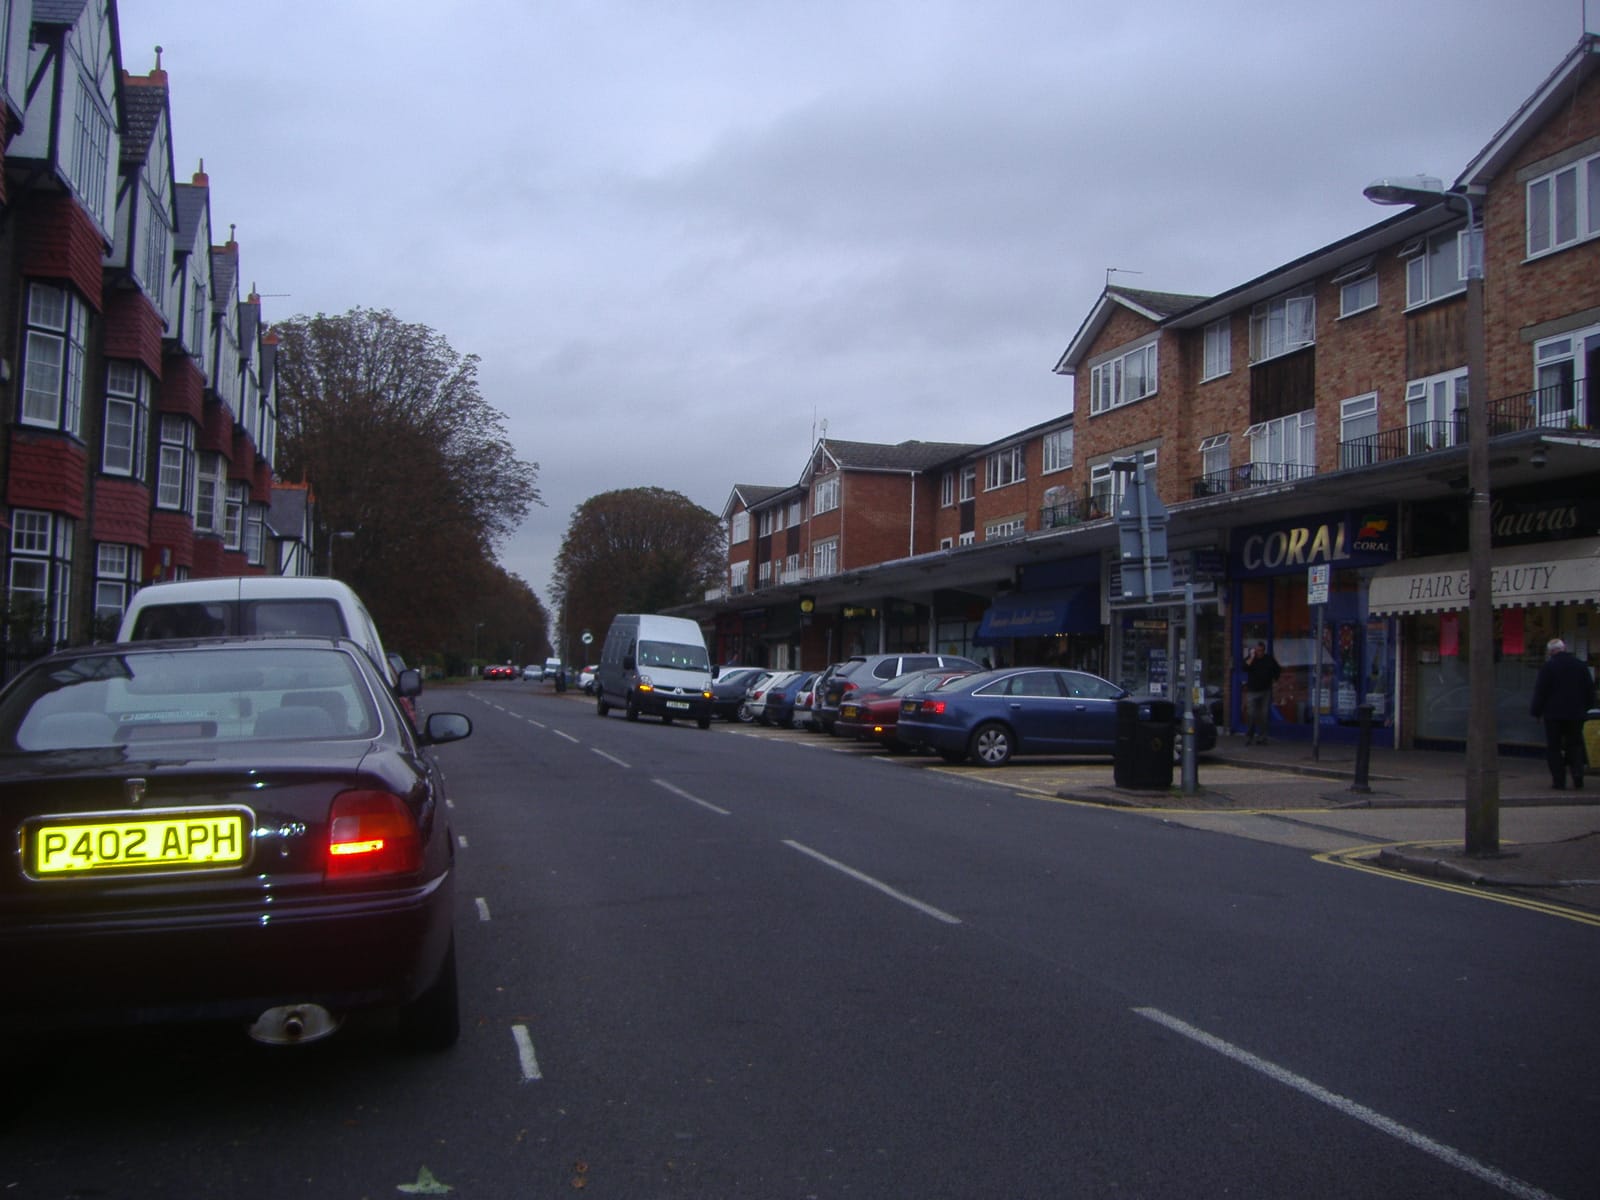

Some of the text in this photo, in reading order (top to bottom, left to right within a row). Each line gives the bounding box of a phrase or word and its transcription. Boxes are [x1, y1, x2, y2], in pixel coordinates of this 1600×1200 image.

[1243, 520, 1351, 571] CORAL
[1353, 540, 1390, 552] CORAL
[1408, 574, 1453, 600] HAIR
[1491, 565, 1557, 593] EAUTY
[46, 828, 147, 864] P402
[162, 823, 236, 857] APH
